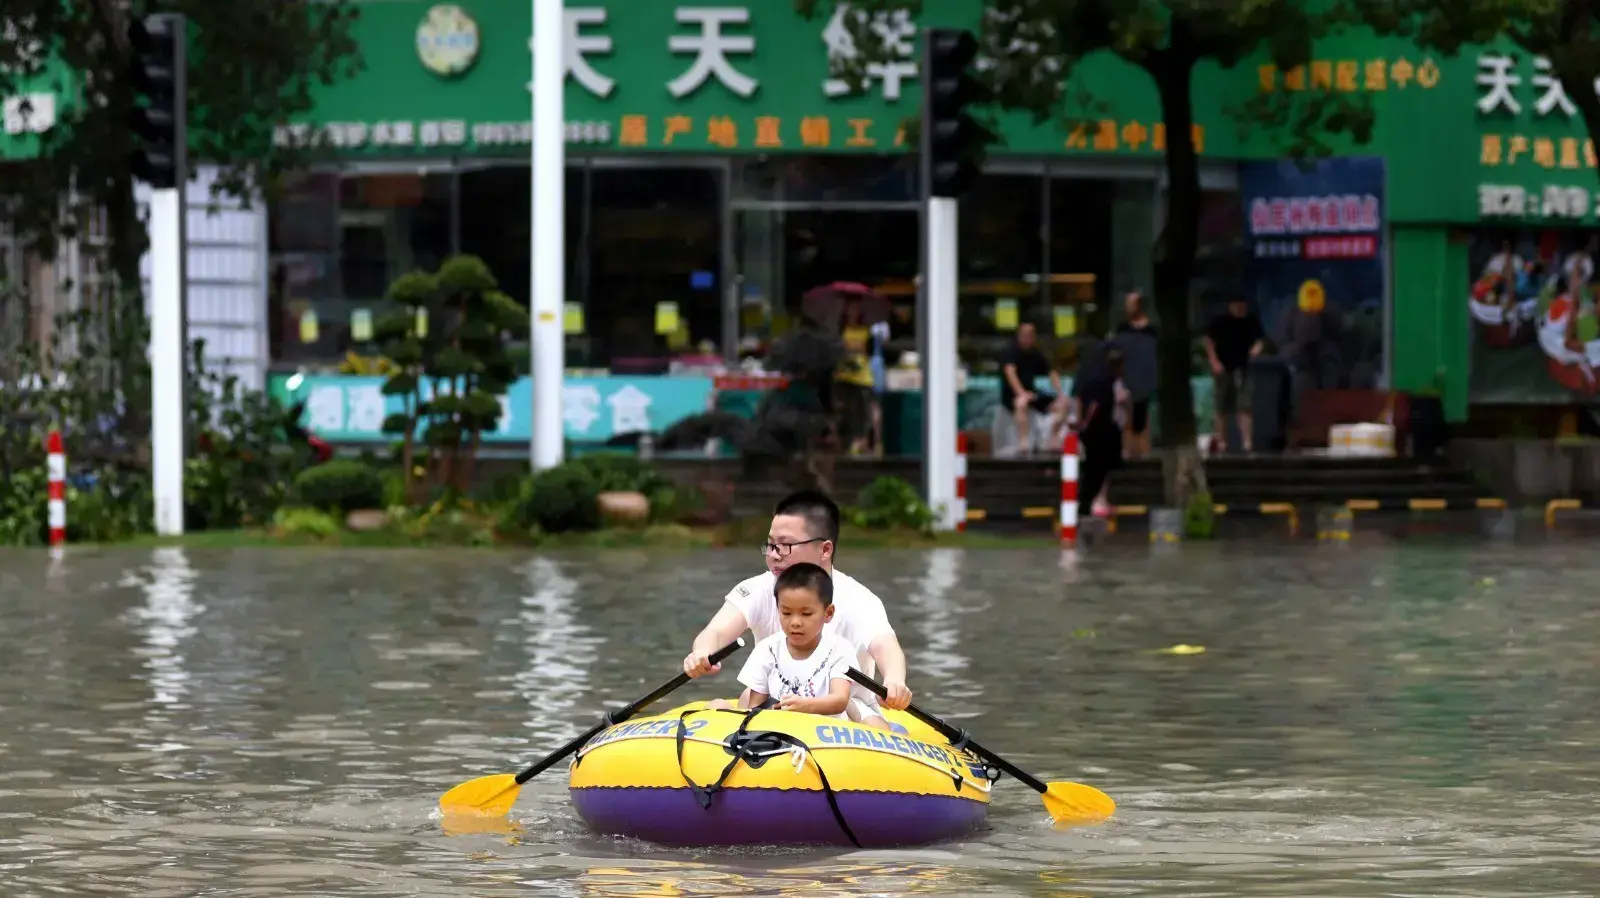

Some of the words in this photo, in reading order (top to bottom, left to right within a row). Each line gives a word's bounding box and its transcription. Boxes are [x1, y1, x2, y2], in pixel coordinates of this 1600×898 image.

[1474, 54, 1600, 116] 天天
[683, 719, 709, 738] 2
[815, 724, 953, 767] CHALLENGER
